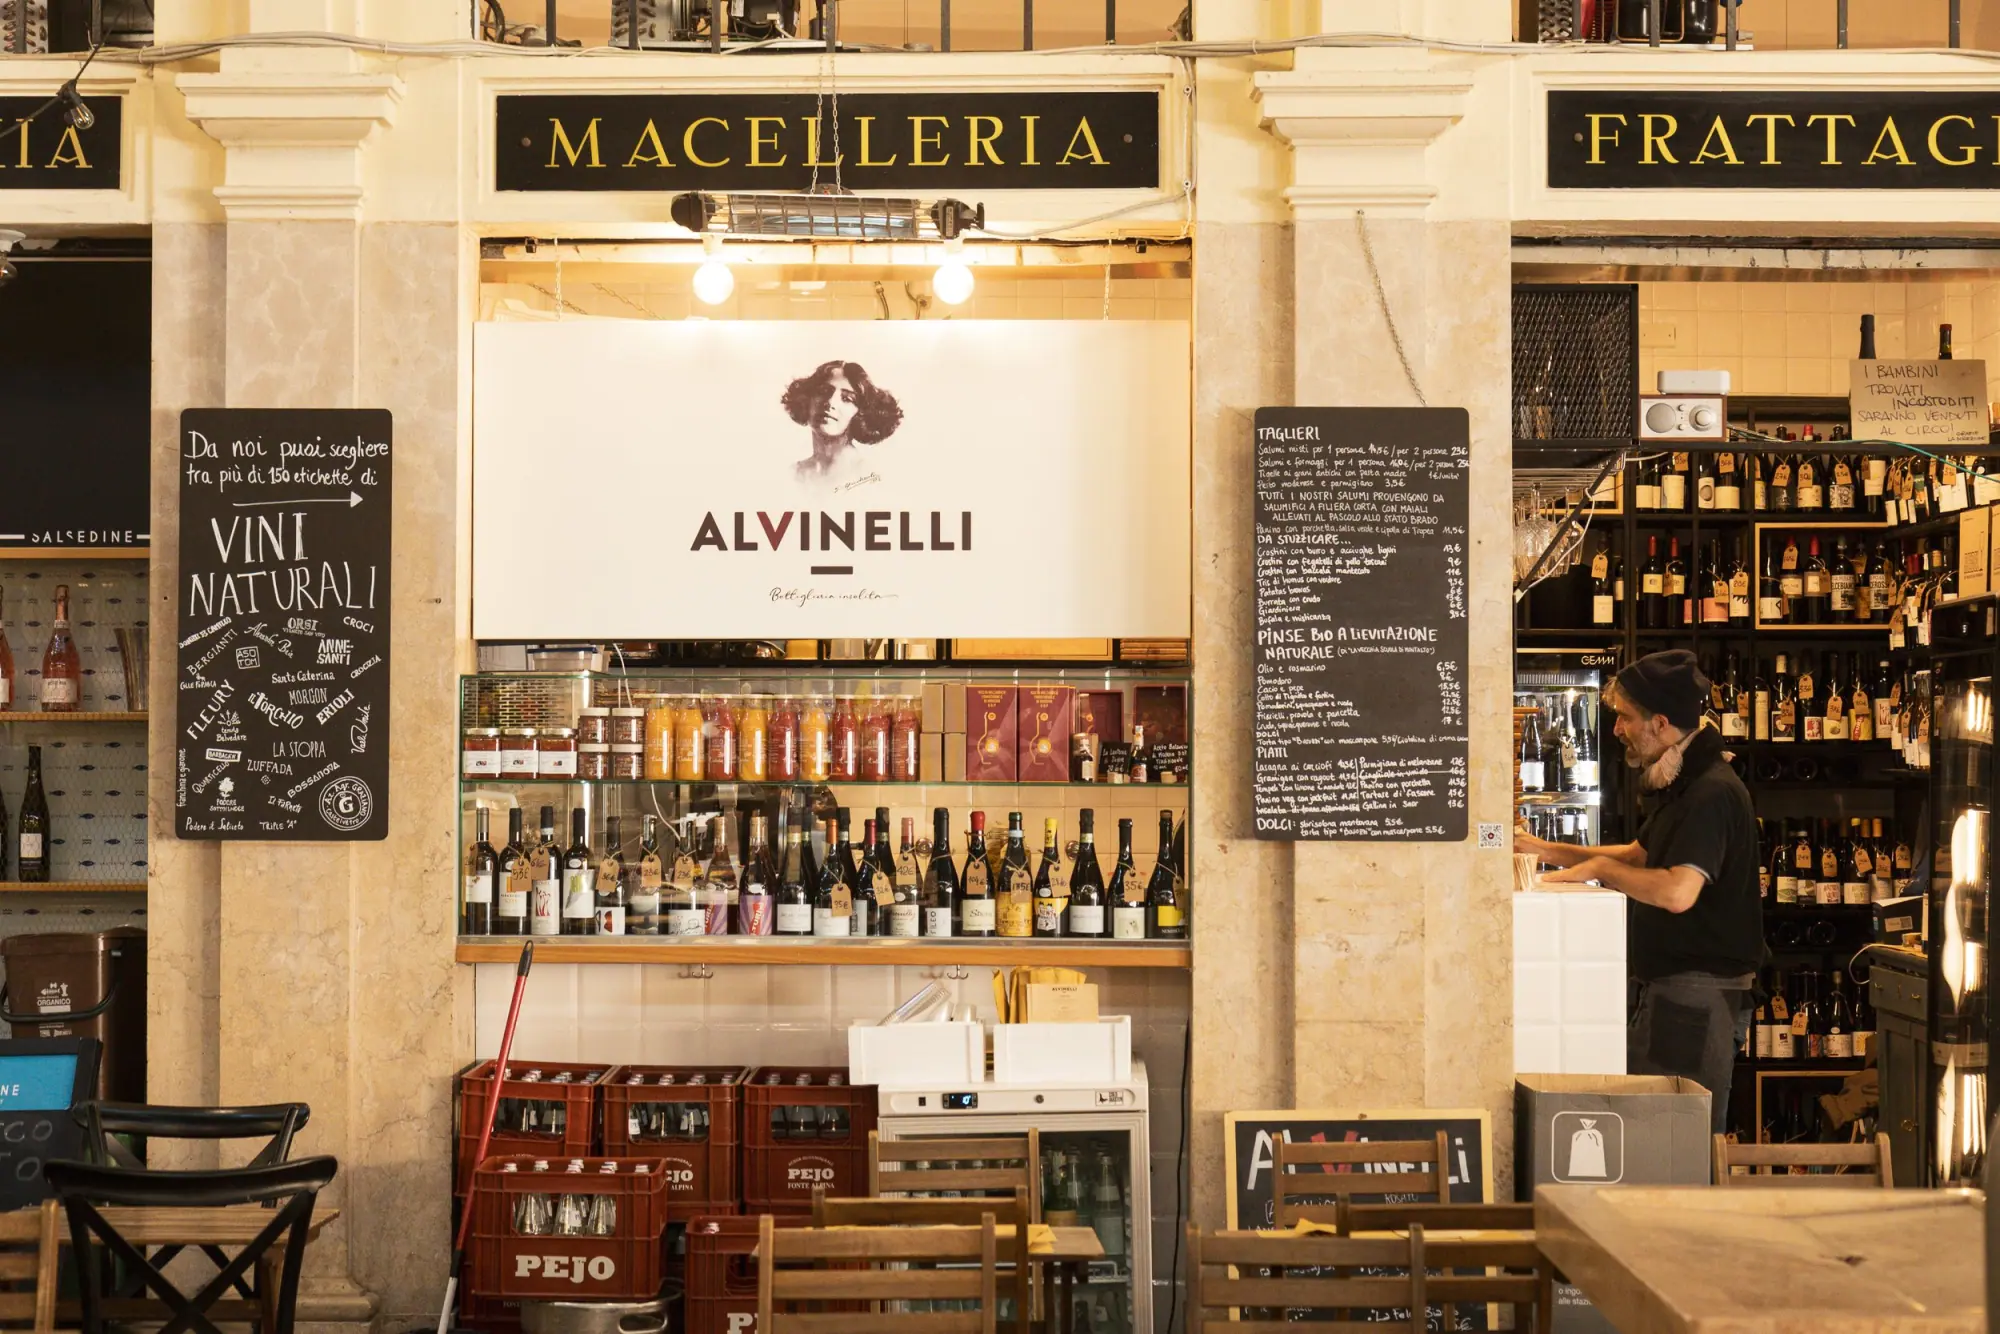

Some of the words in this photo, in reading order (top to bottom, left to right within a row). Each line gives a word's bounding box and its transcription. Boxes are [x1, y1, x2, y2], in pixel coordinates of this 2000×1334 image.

[544, 116, 1111, 168] MACELLERIA
[1876, 364, 1938, 379] BAMBINI
[1865, 384, 1924, 396] TROVATI
[1257, 426, 1320, 442] TAGLIERI
[184, 430, 219, 459] Da
[232, 436, 267, 457] noi
[280, 436, 326, 469] puoi
[329, 435, 389, 470] scegliere
[1258, 443, 1285, 455] Salumi
[1289, 444, 1309, 453] misti
[1312, 446, 1324, 458] per
[1336, 446, 1366, 456] persona
[1258, 457, 1284, 468] Salumi
[1358, 459, 1386, 469] persona
[186, 463, 212, 485] tra
[219, 464, 243, 493] più
[247, 464, 265, 484] di
[268, 466, 290, 485] 150
[294, 467, 353, 485] etichette
[361, 467, 378, 485] di
[1331, 480, 1373, 490] parmigiano
[1300, 491, 1333, 500] NOSTRI
[1336, 491, 1369, 500] SALUMI
[1373, 492, 1428, 503] PROVENGONO
[1433, 494, 1445, 503] DA
[1264, 503, 1306, 511] SALUMIFICI
[1309, 502, 1315, 511] A
[1318, 502, 1351, 511] FILIERA
[1354, 503, 1377, 511] CORTA
[1382, 505, 1397, 513] CON
[1401, 505, 1428, 514] MAIALI
[1272, 512, 1312, 521] ALLEVATI
[1315, 513, 1325, 521] AL
[1329, 513, 1361, 521] PASCOLO
[1384, 514, 1407, 523] STATO
[1410, 516, 1438, 524] BRADO
[211, 512, 309, 563] VINI
[690, 511, 971, 551] ALVINELLI
[1257, 535, 1272, 544] DA
[1257, 547, 1287, 557] Crostini
[1257, 557, 1283, 566] Crostini
[1257, 567, 1283, 578] Crostini
[190, 561, 376, 617] NATURALI
[343, 616, 374, 633] CROCI
[1311, 631, 1333, 642] BIO
[1338, 627, 1347, 641] A
[186, 629, 238, 675] BERGIANTI
[1265, 646, 1334, 660] NATURALE
[1580, 656, 1615, 665] GEMM
[297, 670, 335, 682] Caterina
[1258, 664, 1274, 674] Olio
[1288, 664, 1326, 673] rosmarino
[288, 688, 328, 705] MORGON
[187, 679, 235, 740] FLEURY
[316, 688, 355, 725] ERIOLI
[1256, 730, 1279, 738] DOLCI
[273, 742, 286, 758] LA
[290, 741, 326, 758] STOPPA
[1256, 747, 1288, 758] PIATTI
[247, 759, 293, 775] ZUFFADA
[1256, 761, 1287, 776] Lasagna
[1291, 762, 1300, 771] ai
[37, 998, 71, 1006] ORGANICO
[788, 1168, 834, 1181] PEJO
[515, 1255, 616, 1284] PEJO
